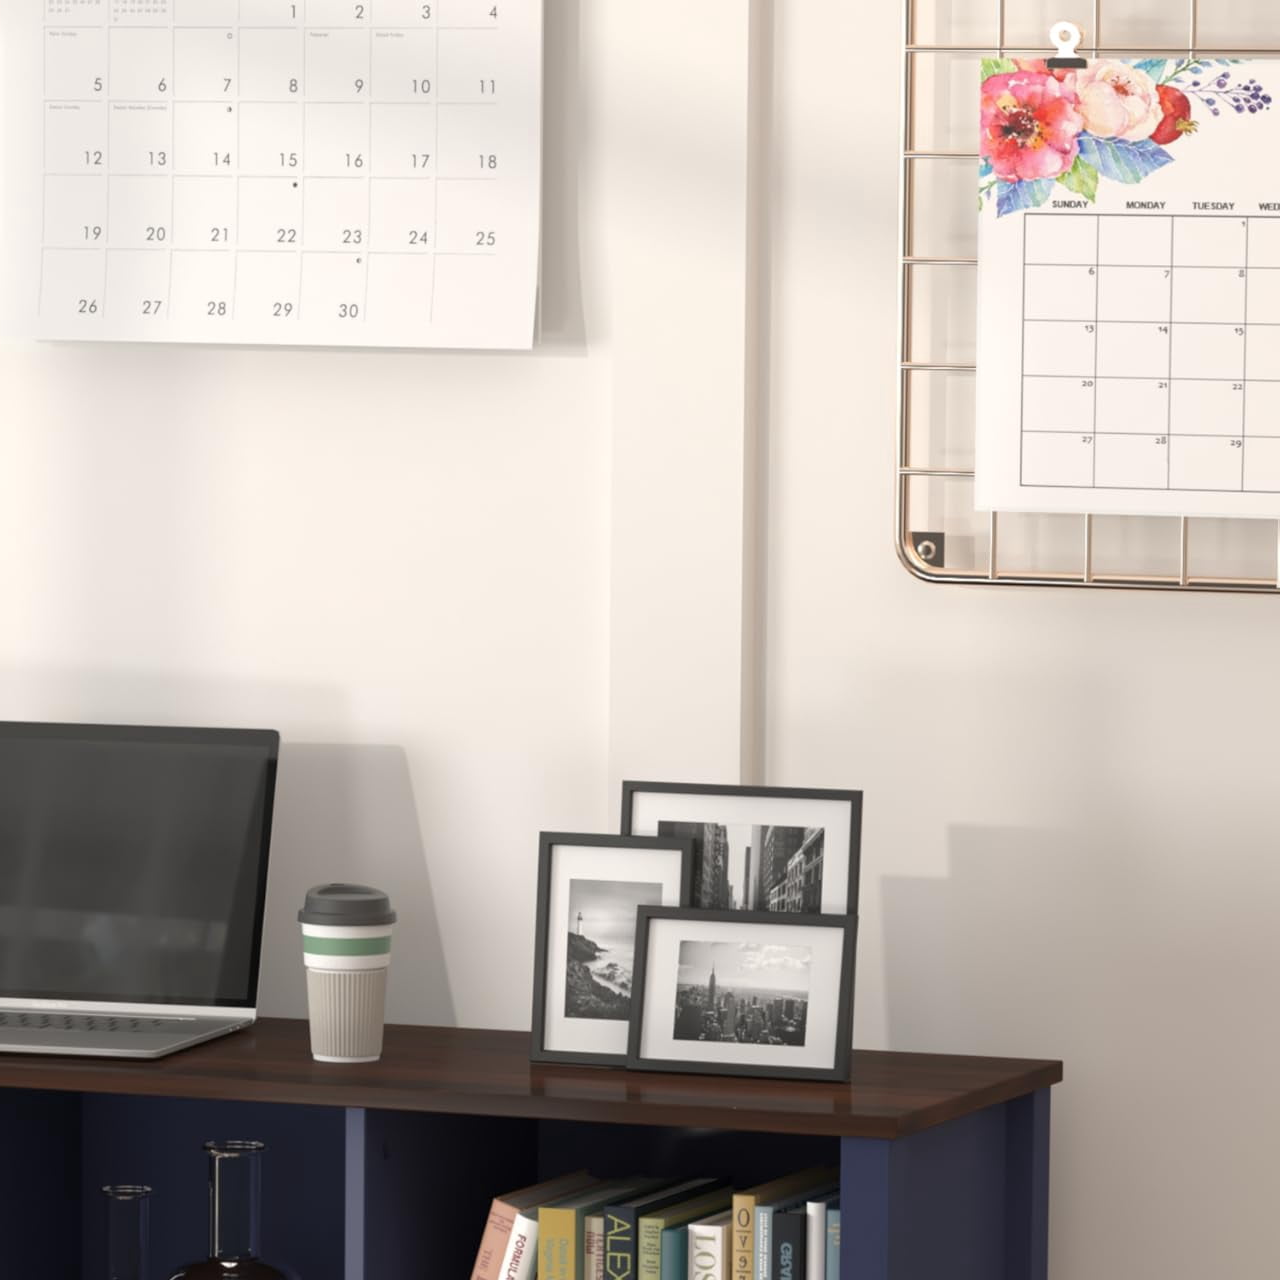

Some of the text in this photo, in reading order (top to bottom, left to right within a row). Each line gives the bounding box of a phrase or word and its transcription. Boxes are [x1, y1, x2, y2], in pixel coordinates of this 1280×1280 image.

[291, 4, 498, 20] 1 2 3 4
[93, 77, 495, 94] 5 6 7 8 9 10 11
[85, 150, 497, 169] 12 13 14 15 16 17 18
[1052, 200, 1088, 209] SUNDAY
[1126, 201, 1166, 210] MONDAY
[1192, 202, 1235, 211] TUESDAY
[84, 225, 496, 246] 19 20 21 22 23 24 25
[1088, 267, 1246, 279] 6 7 8
[78, 299, 359, 319] 26 27 28 29 30
[1084, 324, 1245, 336] 13 14 15
[1081, 380, 1094, 388] 20
[1232, 383, 1243, 391] 22
[1082, 435, 1243, 449] 27 28 29
[505, 1233, 527, 1280] FORMULA
